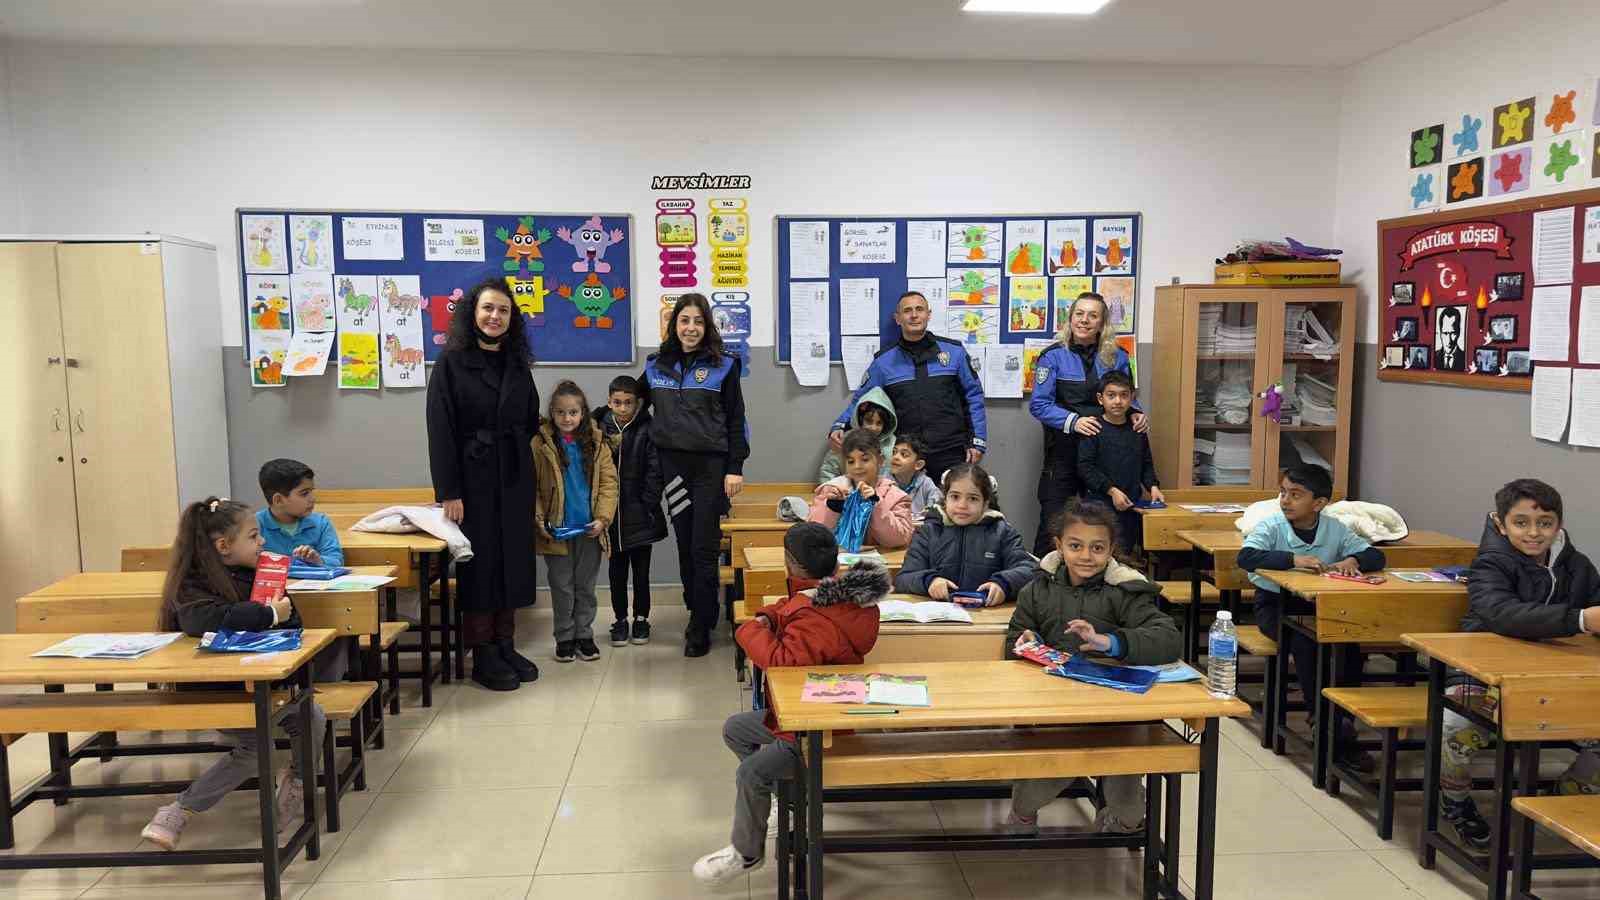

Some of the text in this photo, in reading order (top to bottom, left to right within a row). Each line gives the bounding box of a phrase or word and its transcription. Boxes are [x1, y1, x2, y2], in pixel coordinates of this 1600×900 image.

[652, 173, 751, 190] MEVSİMLER
[1411, 226, 1498, 256] ATATÜRK KÖŞESİ
[353, 318, 364, 326] at
[396, 317, 407, 326] at
[400, 371, 411, 380] at
